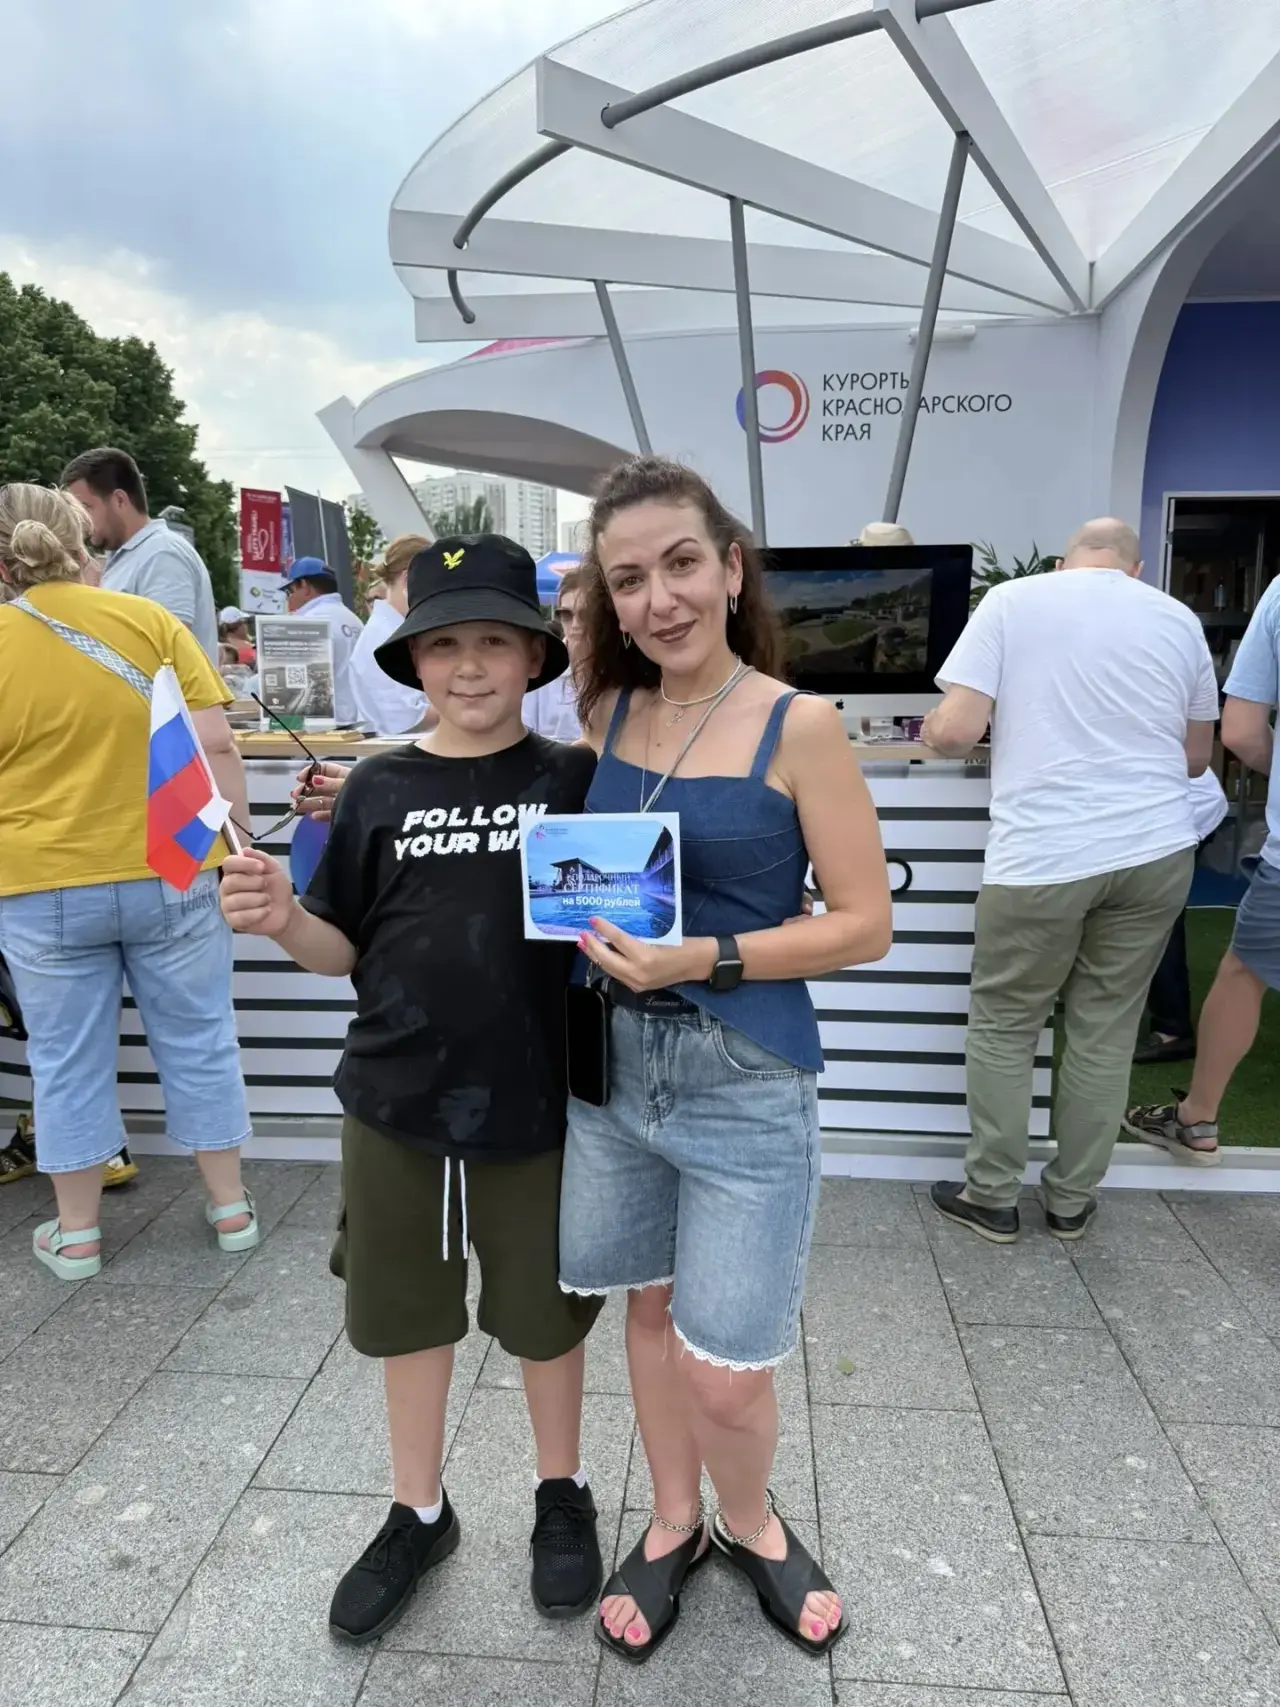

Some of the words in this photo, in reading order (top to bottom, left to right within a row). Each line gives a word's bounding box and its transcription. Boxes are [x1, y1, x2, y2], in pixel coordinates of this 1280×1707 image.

[822, 394, 1012, 416] КРАСНОАРСКОГО
[821, 423, 871, 441] КРАЯ
[394, 832, 480, 861] YOUR
[563, 882, 640, 895] СЕРТИФИКАТ
[562, 897, 574, 905] на
[575, 896, 602, 905] 5000
[604, 896, 641, 908] рублей
